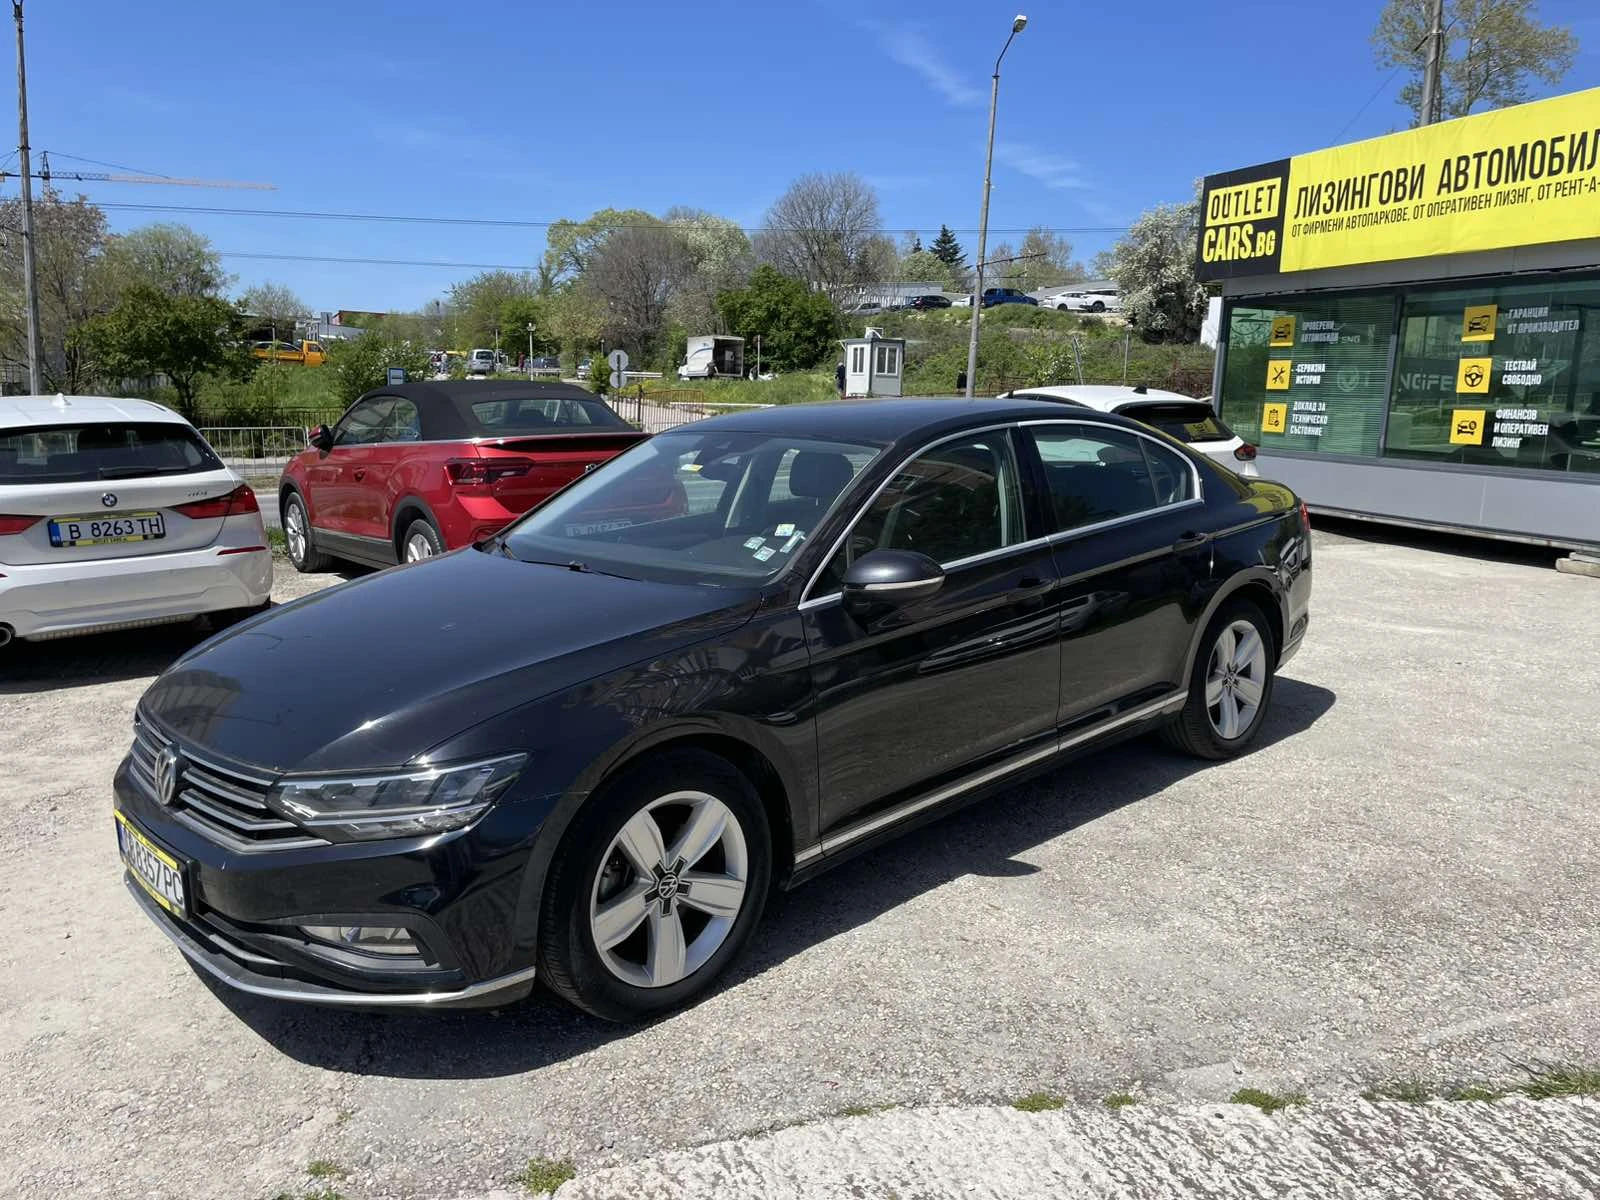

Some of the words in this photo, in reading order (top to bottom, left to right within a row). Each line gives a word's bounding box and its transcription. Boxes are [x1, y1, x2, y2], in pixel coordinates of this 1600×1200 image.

[1294, 163, 1426, 219] ЛИЗИНГОВИ
[1211, 184, 1276, 220] OUTLET
[1292, 223, 1302, 238] ОТ
[1303, 217, 1344, 235] ФИРМЕНИ
[1413, 204, 1426, 220] ОТ
[1427, 191, 1493, 218] ОПЕРАТИВЕН
[1537, 183, 1552, 201] ОТ
[1202, 223, 1276, 263] CARS.BG
[1508, 306, 1548, 319] ГАРАНЦИЯ
[1507, 323, 1517, 334] ОТ
[1505, 358, 1537, 371] ТЕСТВАЙ
[1502, 374, 1542, 386] СВОБОДНО
[1293, 400, 1317, 412] ДОКЛАД
[1318, 401, 1326, 412] ЗА
[1292, 413, 1328, 425] ТЕХНИЧЕСКО
[1495, 409, 1538, 420] ФИНАНСОВ
[1493, 422, 1500, 433] И
[1501, 423, 1549, 436] ОПЕРАТИВЕН
[1491, 436, 1523, 448] ЛИЗИНГ
[68, 524, 81, 539] B
[91, 520, 134, 537] 8263
